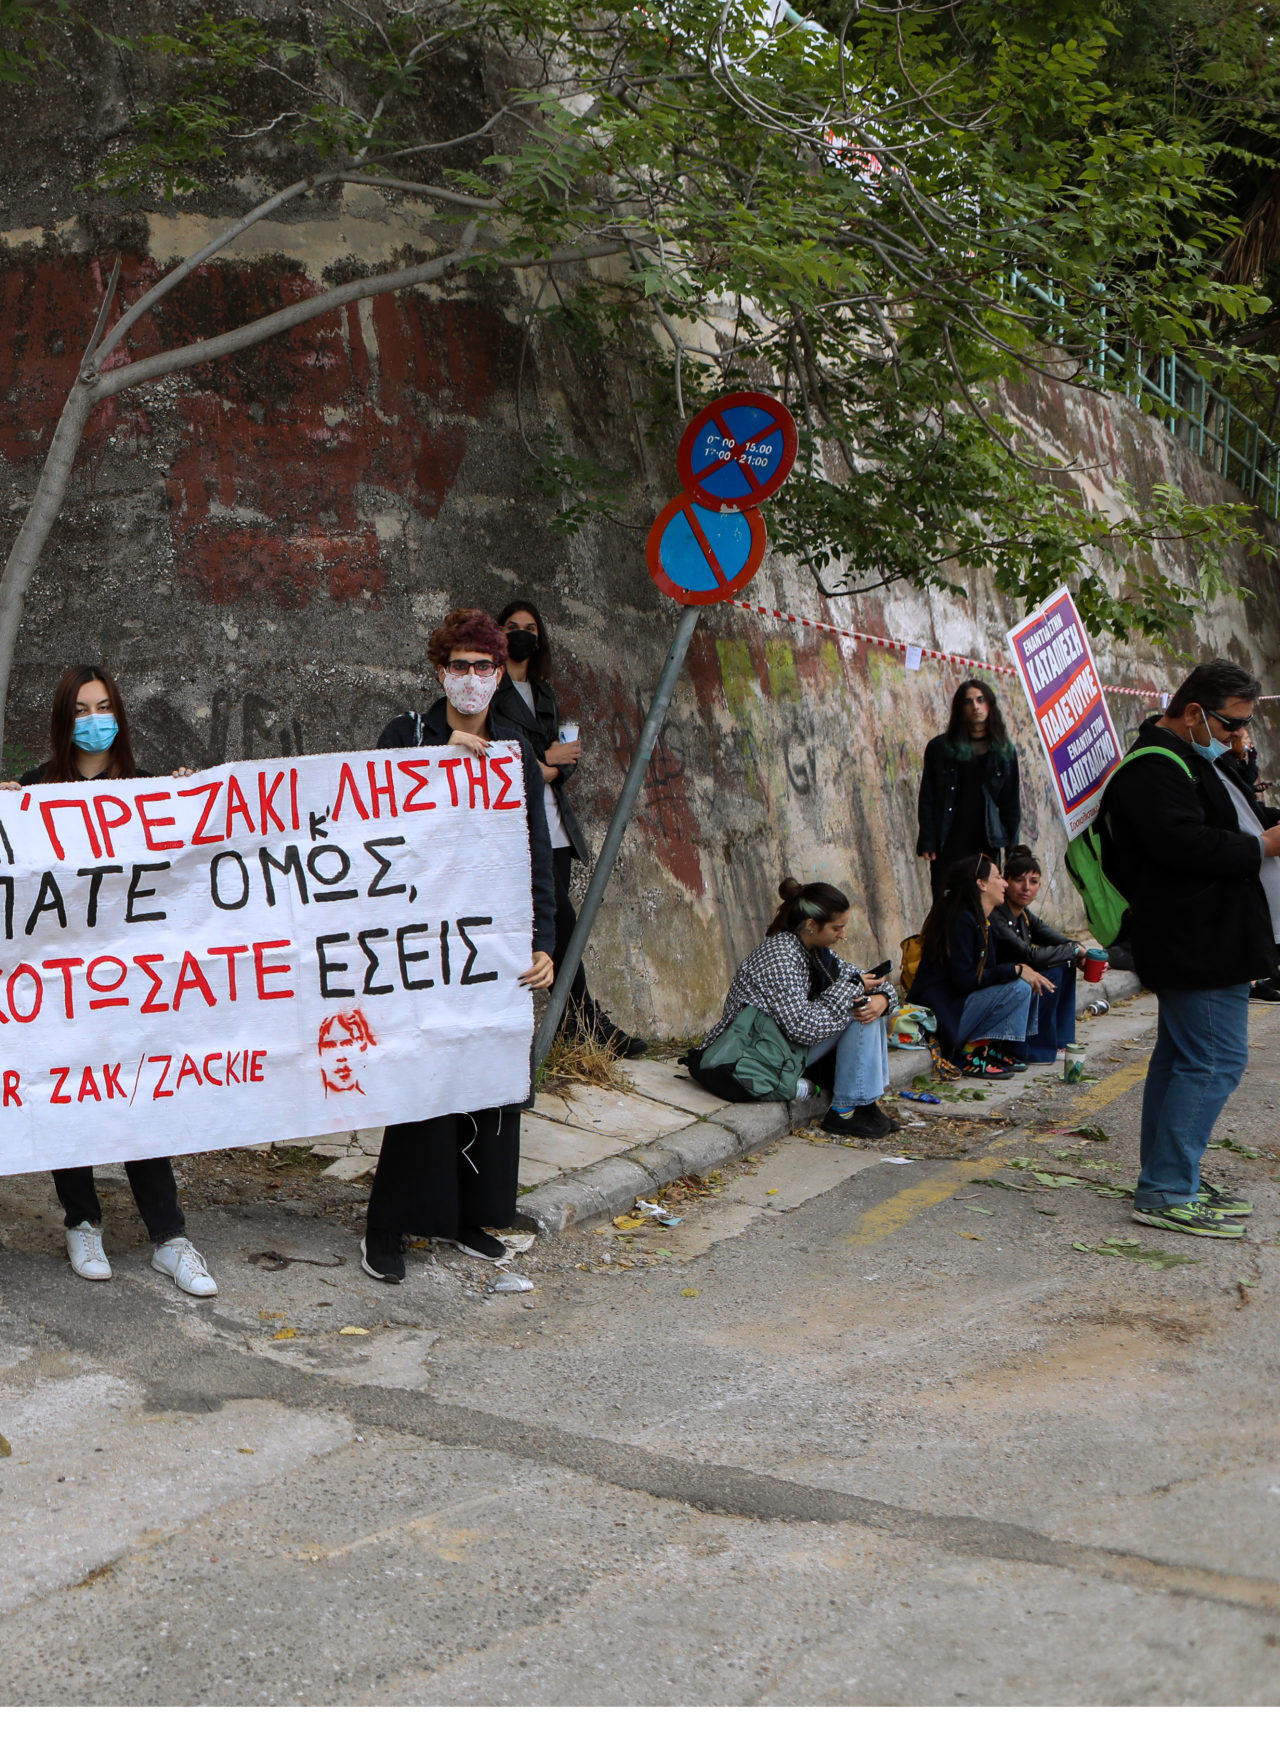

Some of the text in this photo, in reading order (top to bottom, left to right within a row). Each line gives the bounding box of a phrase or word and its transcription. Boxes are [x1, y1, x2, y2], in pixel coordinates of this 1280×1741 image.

[1025, 622, 1084, 695] ΚΑΤΑΠΙΕΣΗ
[1040, 664, 1099, 749] ΠΑΛΕΥΟΥΜΕ
[1060, 730, 1116, 802] ΚΑΠΙΤΑΛΙΣΜΟ
[316, 917, 498, 998] ΕΣΕΙΣ
